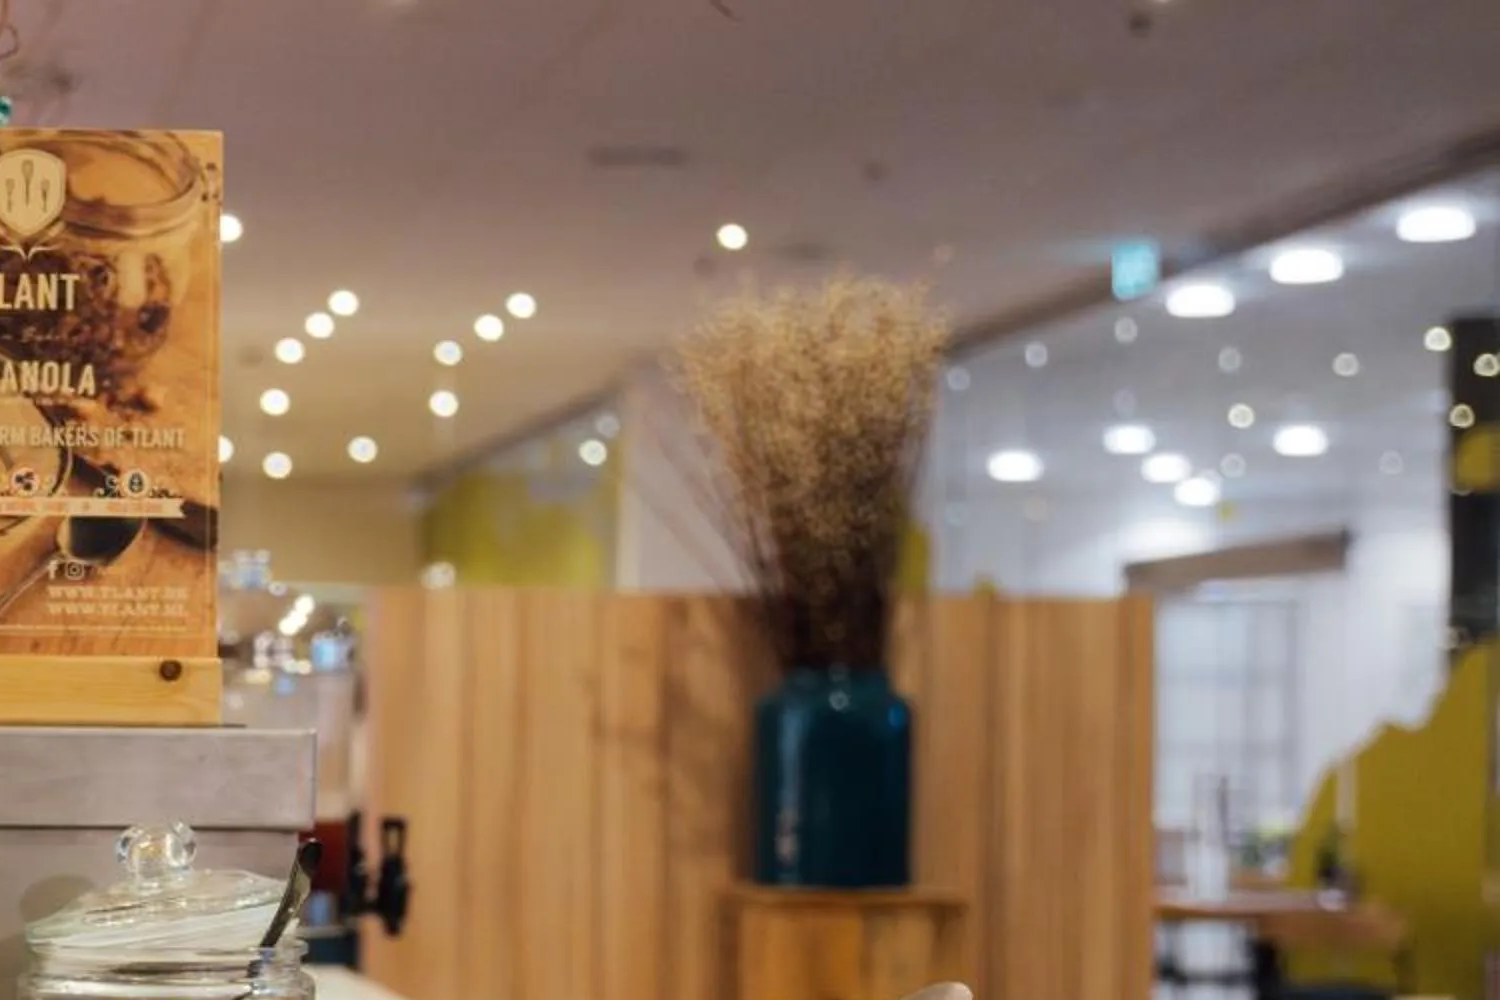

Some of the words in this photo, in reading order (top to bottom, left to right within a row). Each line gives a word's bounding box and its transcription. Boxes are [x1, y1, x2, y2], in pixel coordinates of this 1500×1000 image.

[31, 426, 98, 448] BAKERS
[105, 428, 125, 448] OF
[132, 428, 186, 449] TLANT
